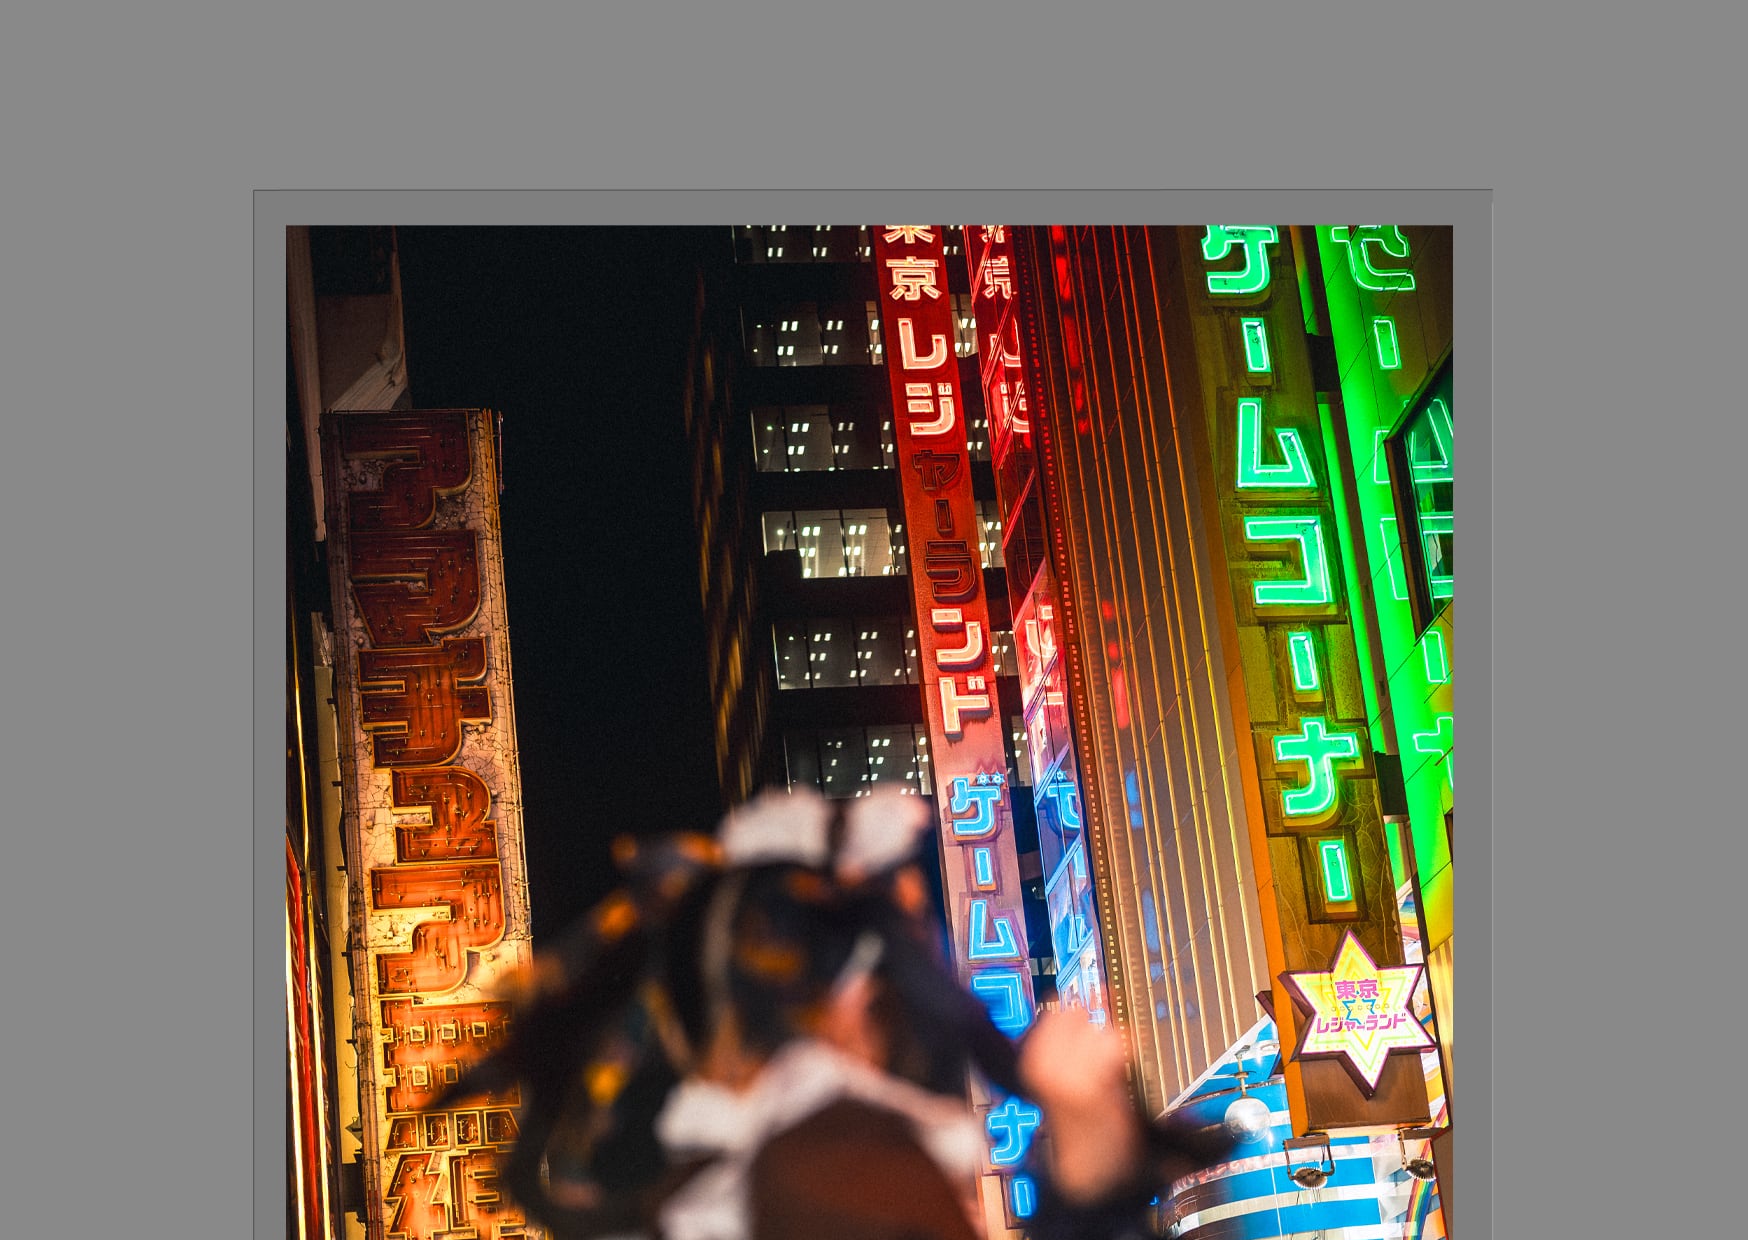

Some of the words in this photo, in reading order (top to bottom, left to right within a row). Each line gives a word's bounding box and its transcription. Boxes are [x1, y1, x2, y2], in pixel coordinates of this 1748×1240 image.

[1335, 979, 1379, 999] 東京
[1317, 1013, 1406, 1033] レジャーランド
